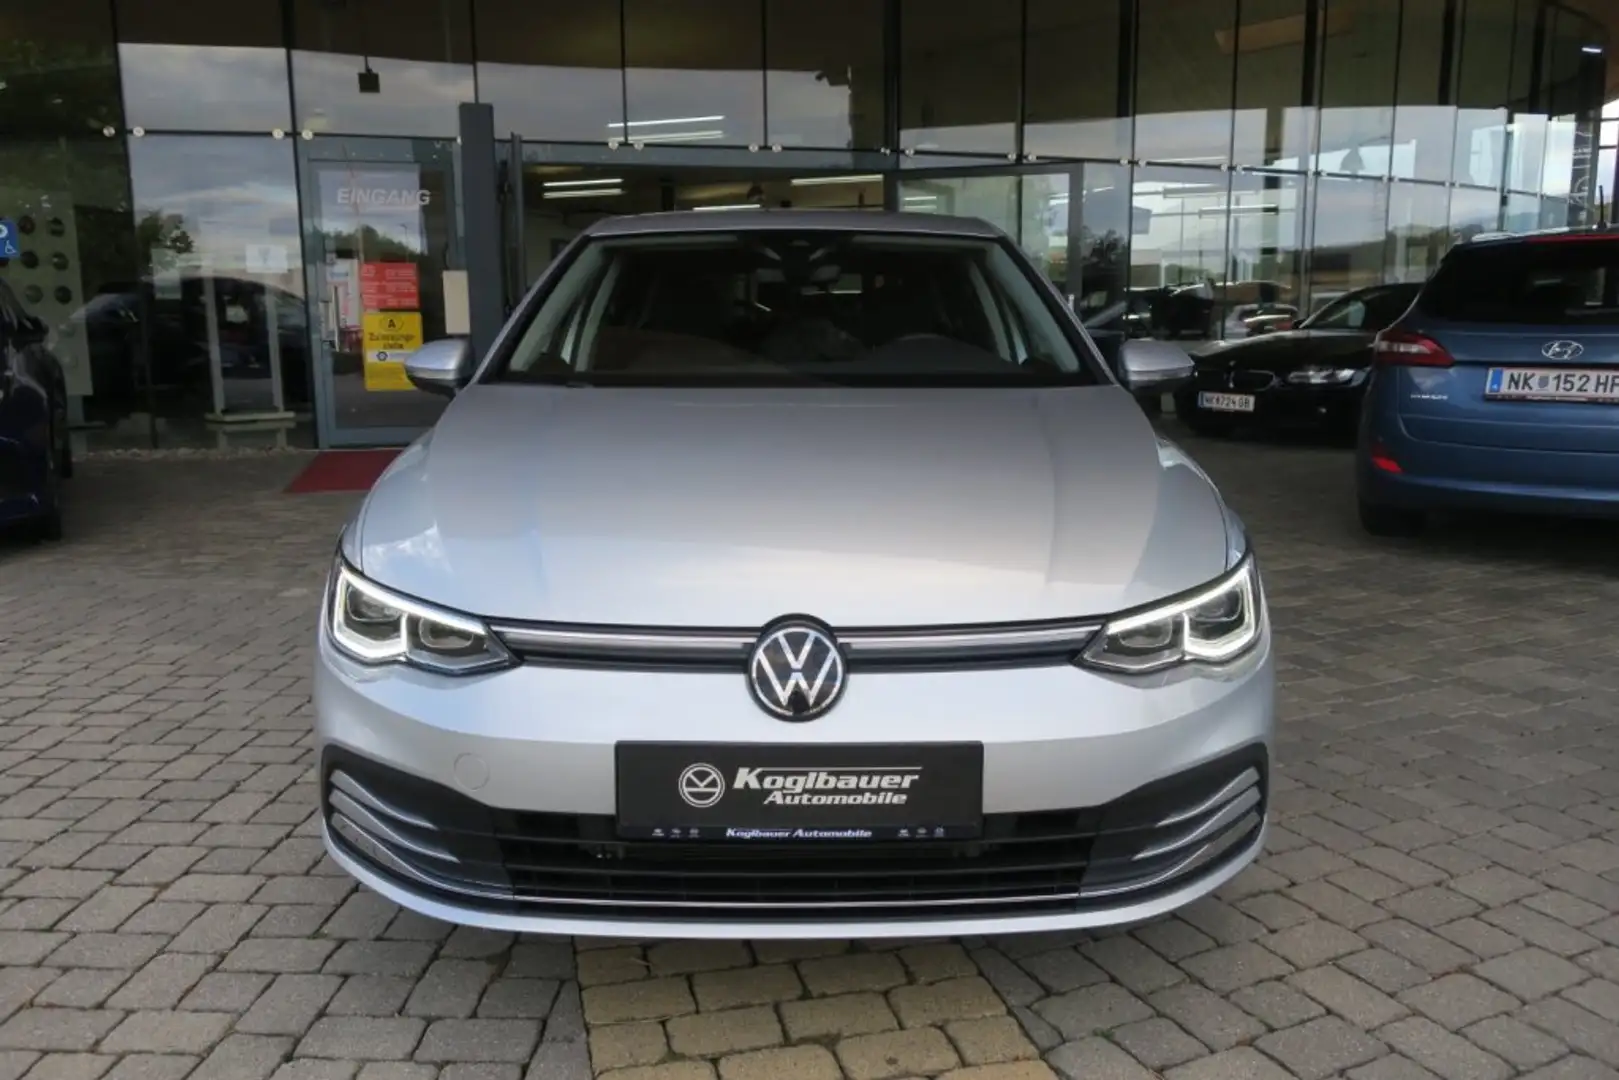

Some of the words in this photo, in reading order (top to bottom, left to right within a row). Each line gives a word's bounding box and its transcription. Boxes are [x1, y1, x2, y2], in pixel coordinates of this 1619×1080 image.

[337, 188, 431, 205] EINGANG
[387, 319, 396, 328] A
[1507, 373, 1535, 391] NK
[1552, 374, 1590, 392] 152
[733, 767, 919, 793] Koglbauer
[764, 791, 908, 806] Automobile
[725, 828, 790, 839] Koglbauer
[792, 828, 873, 838] Automobile
